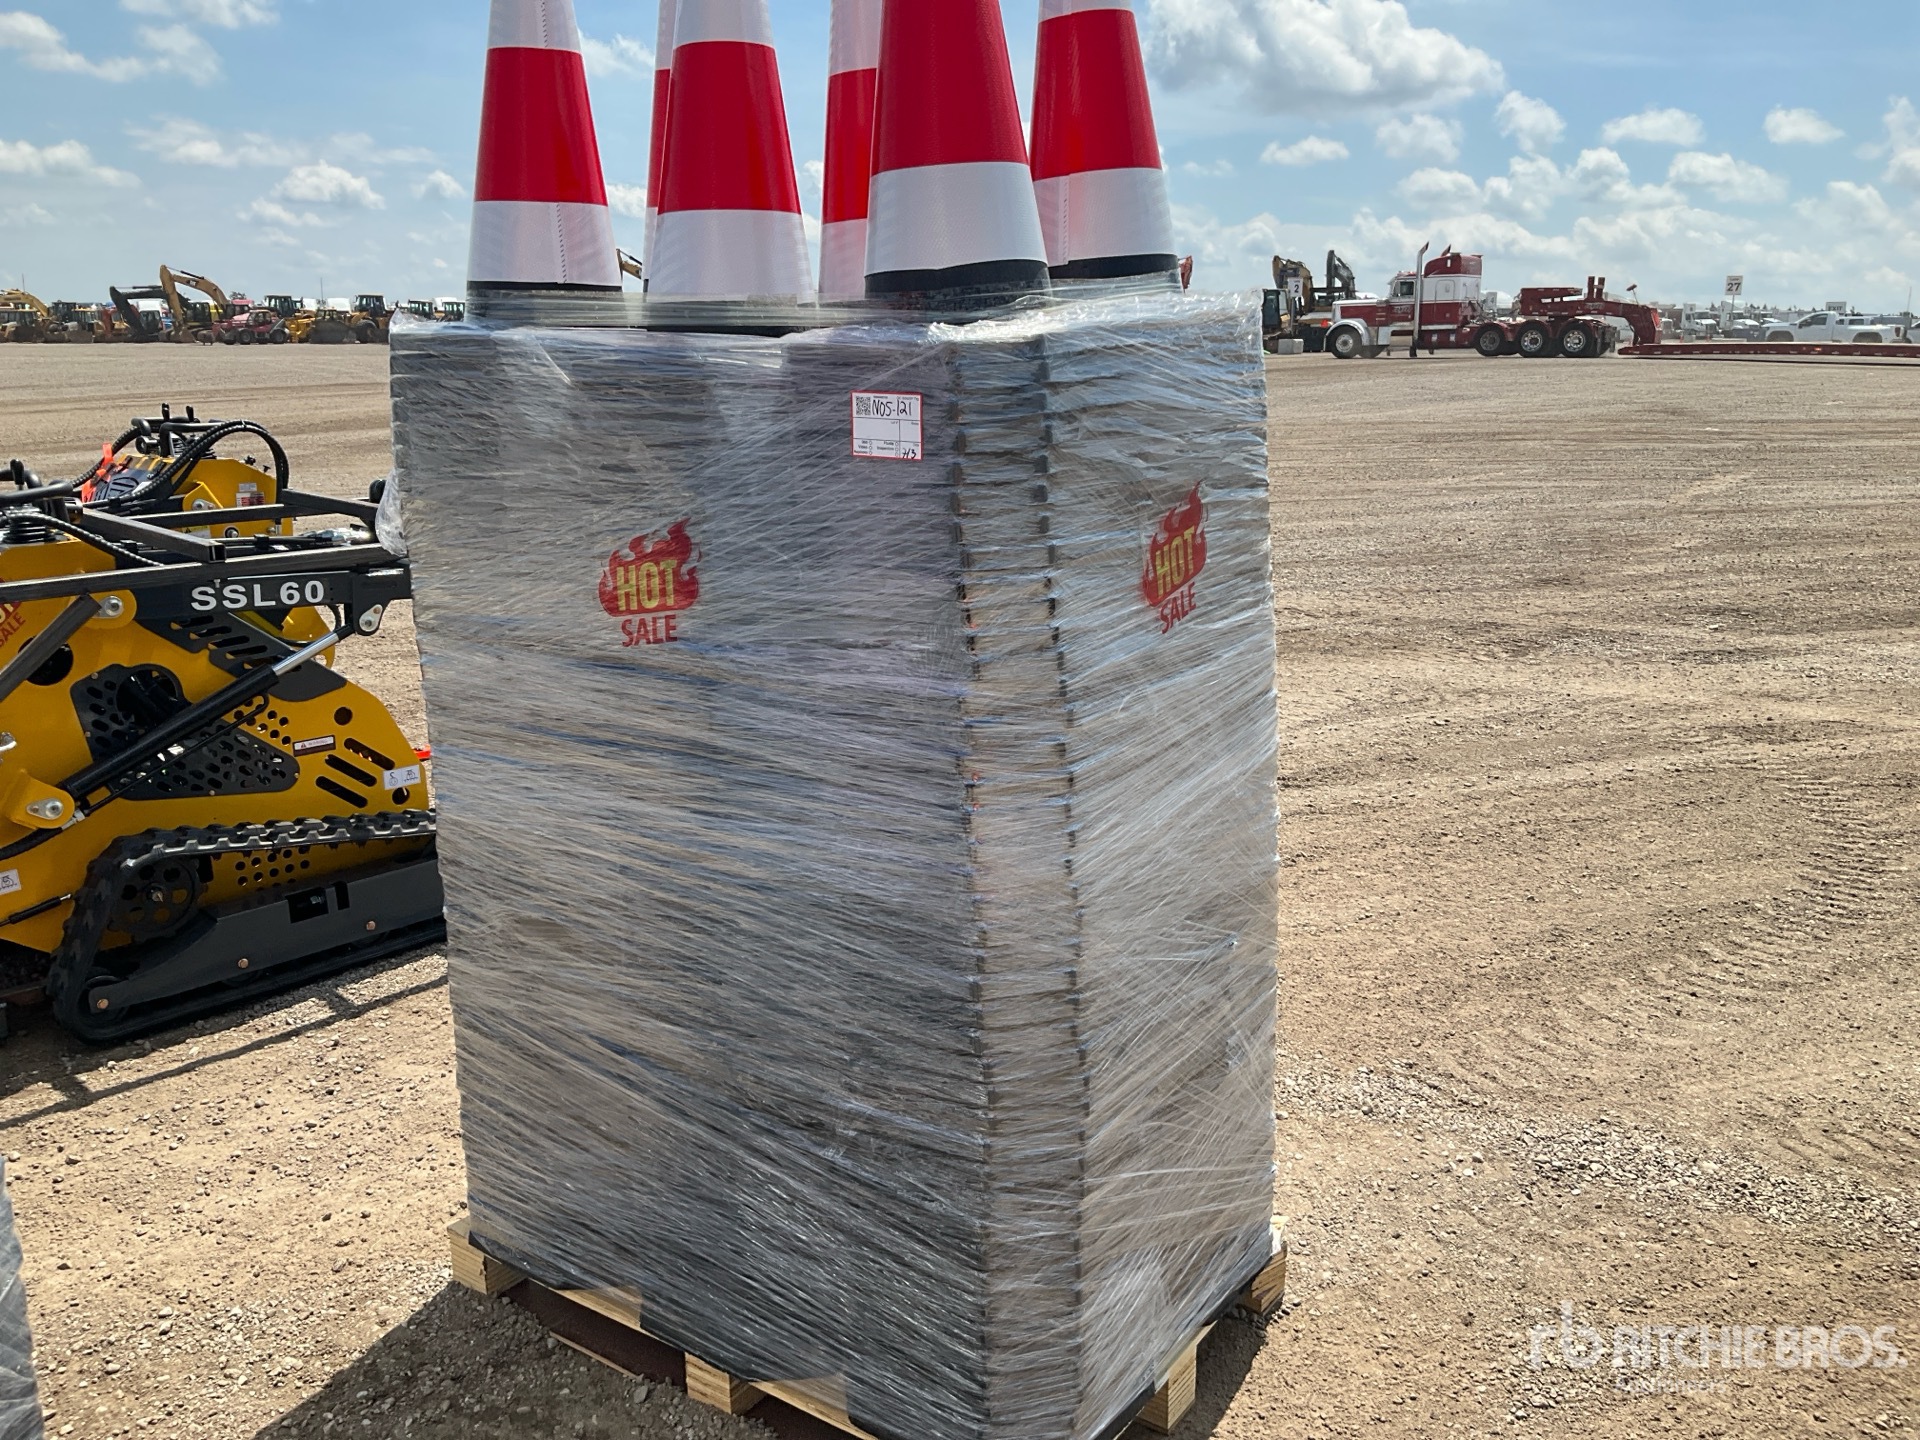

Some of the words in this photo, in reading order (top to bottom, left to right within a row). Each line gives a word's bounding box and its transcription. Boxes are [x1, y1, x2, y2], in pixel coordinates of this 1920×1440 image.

[1294, 284, 1299, 293] 2
[1726, 282, 1741, 292] 27
[1155, 525, 1195, 599] HOT
[190, 580, 325, 611] SSL60
[616, 559, 678, 611] HOT
[1160, 581, 1197, 635] SALE
[621, 614, 678, 647] SALE
